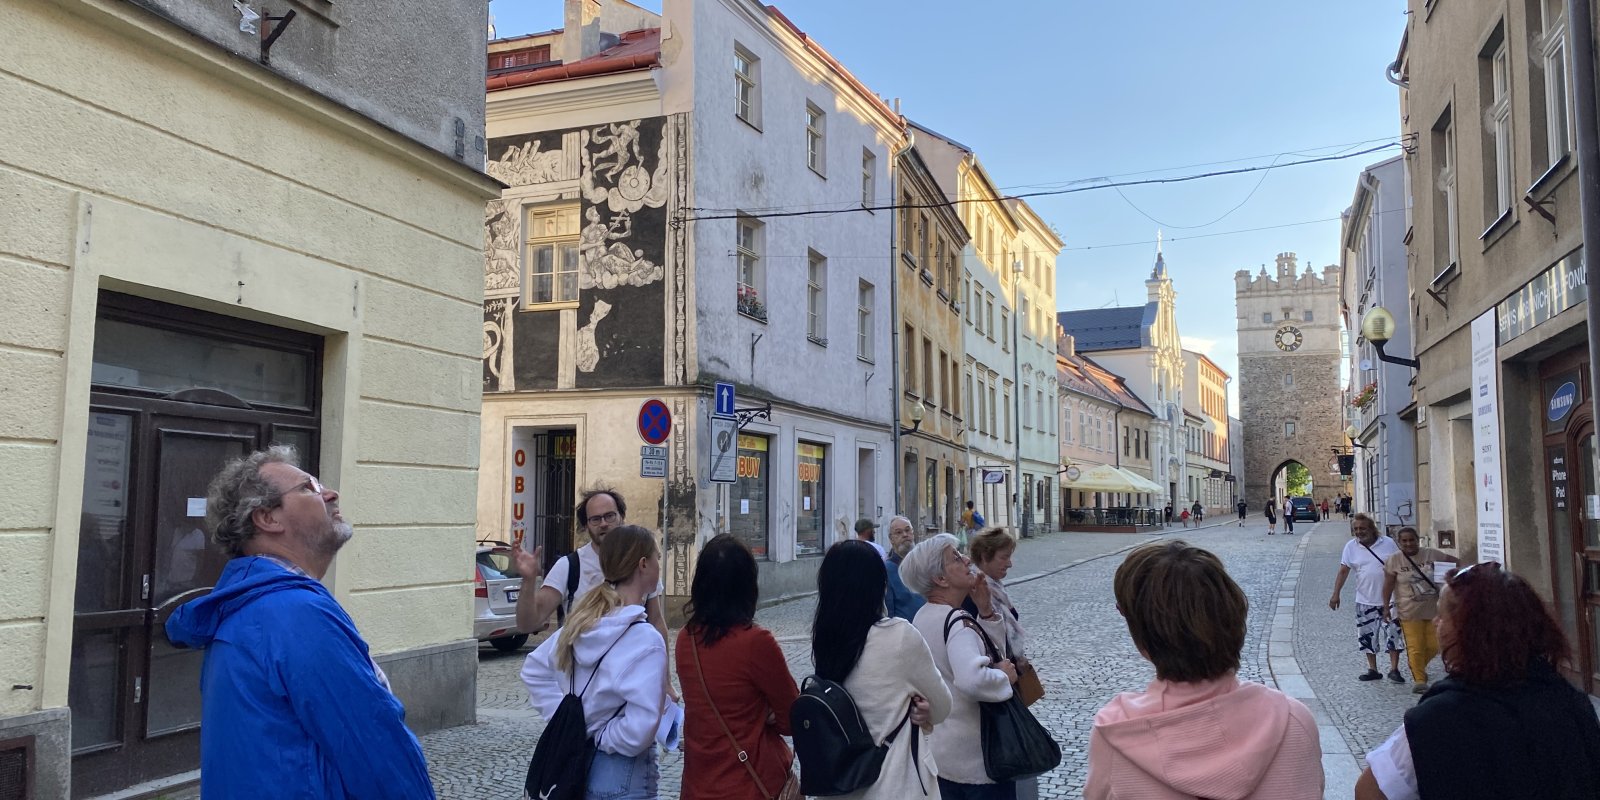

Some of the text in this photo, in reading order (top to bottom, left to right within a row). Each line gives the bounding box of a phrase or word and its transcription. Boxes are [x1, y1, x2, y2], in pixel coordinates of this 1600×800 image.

[1550, 259, 1586, 302] TELFONŮ
[1551, 393, 1573, 410] SAMSUNG
[737, 455, 761, 478] BUV
[798, 462, 821, 482] OBUV
[1552, 470, 1566, 480] iPhone
[1555, 487, 1565, 497] iPad
